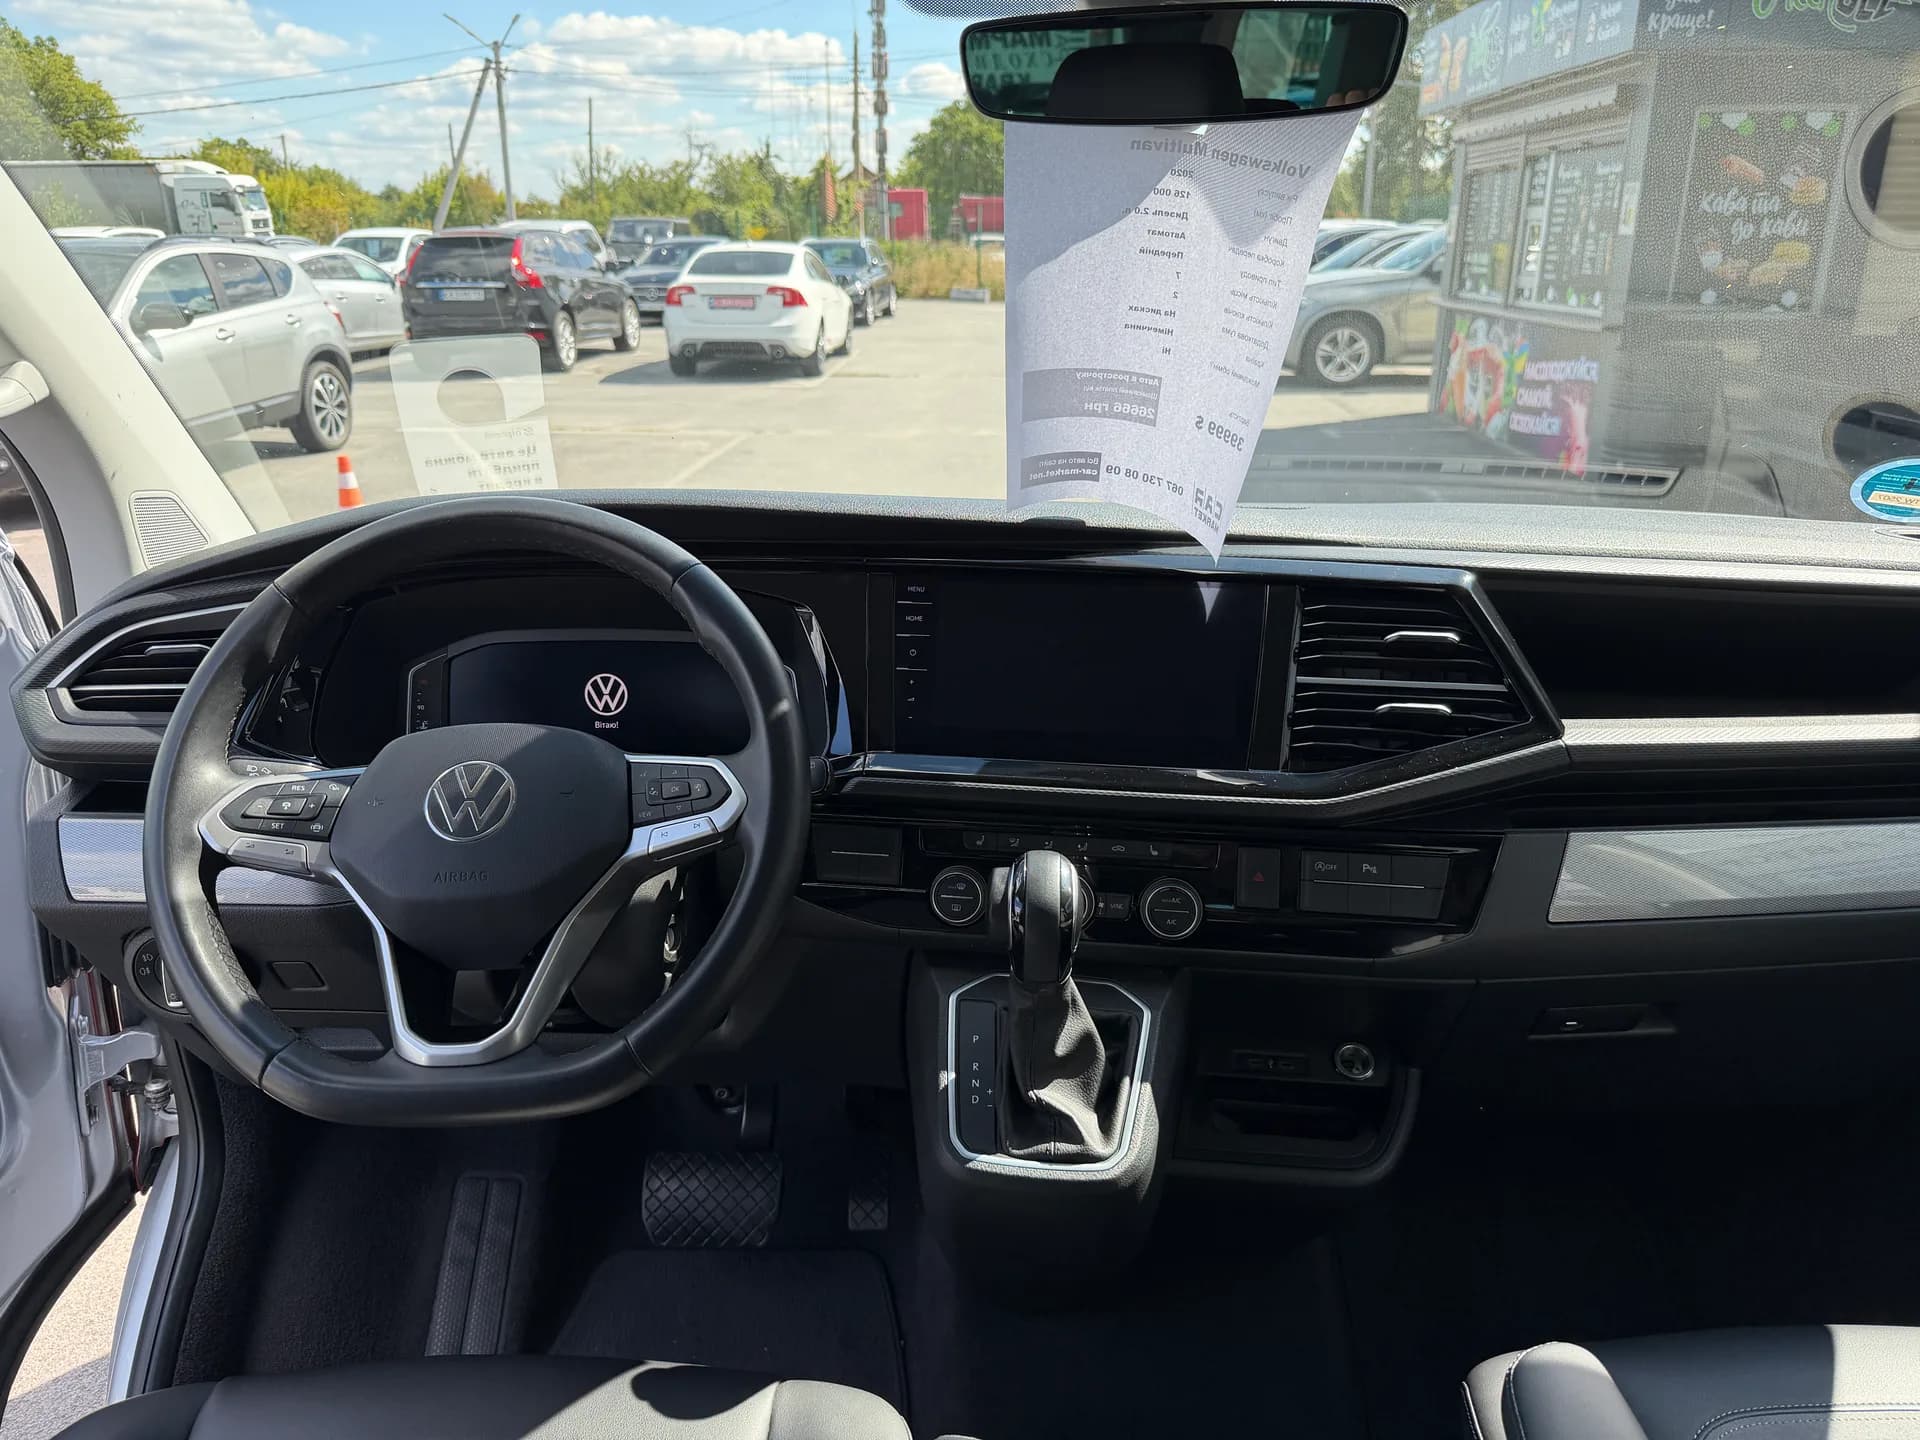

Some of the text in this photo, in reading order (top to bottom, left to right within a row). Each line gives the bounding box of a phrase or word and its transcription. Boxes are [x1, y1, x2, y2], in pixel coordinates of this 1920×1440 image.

[907, 585, 925, 593] MENU
[594, 720, 619, 729] Вітаю!
[433, 871, 489, 883] AIRBAG
